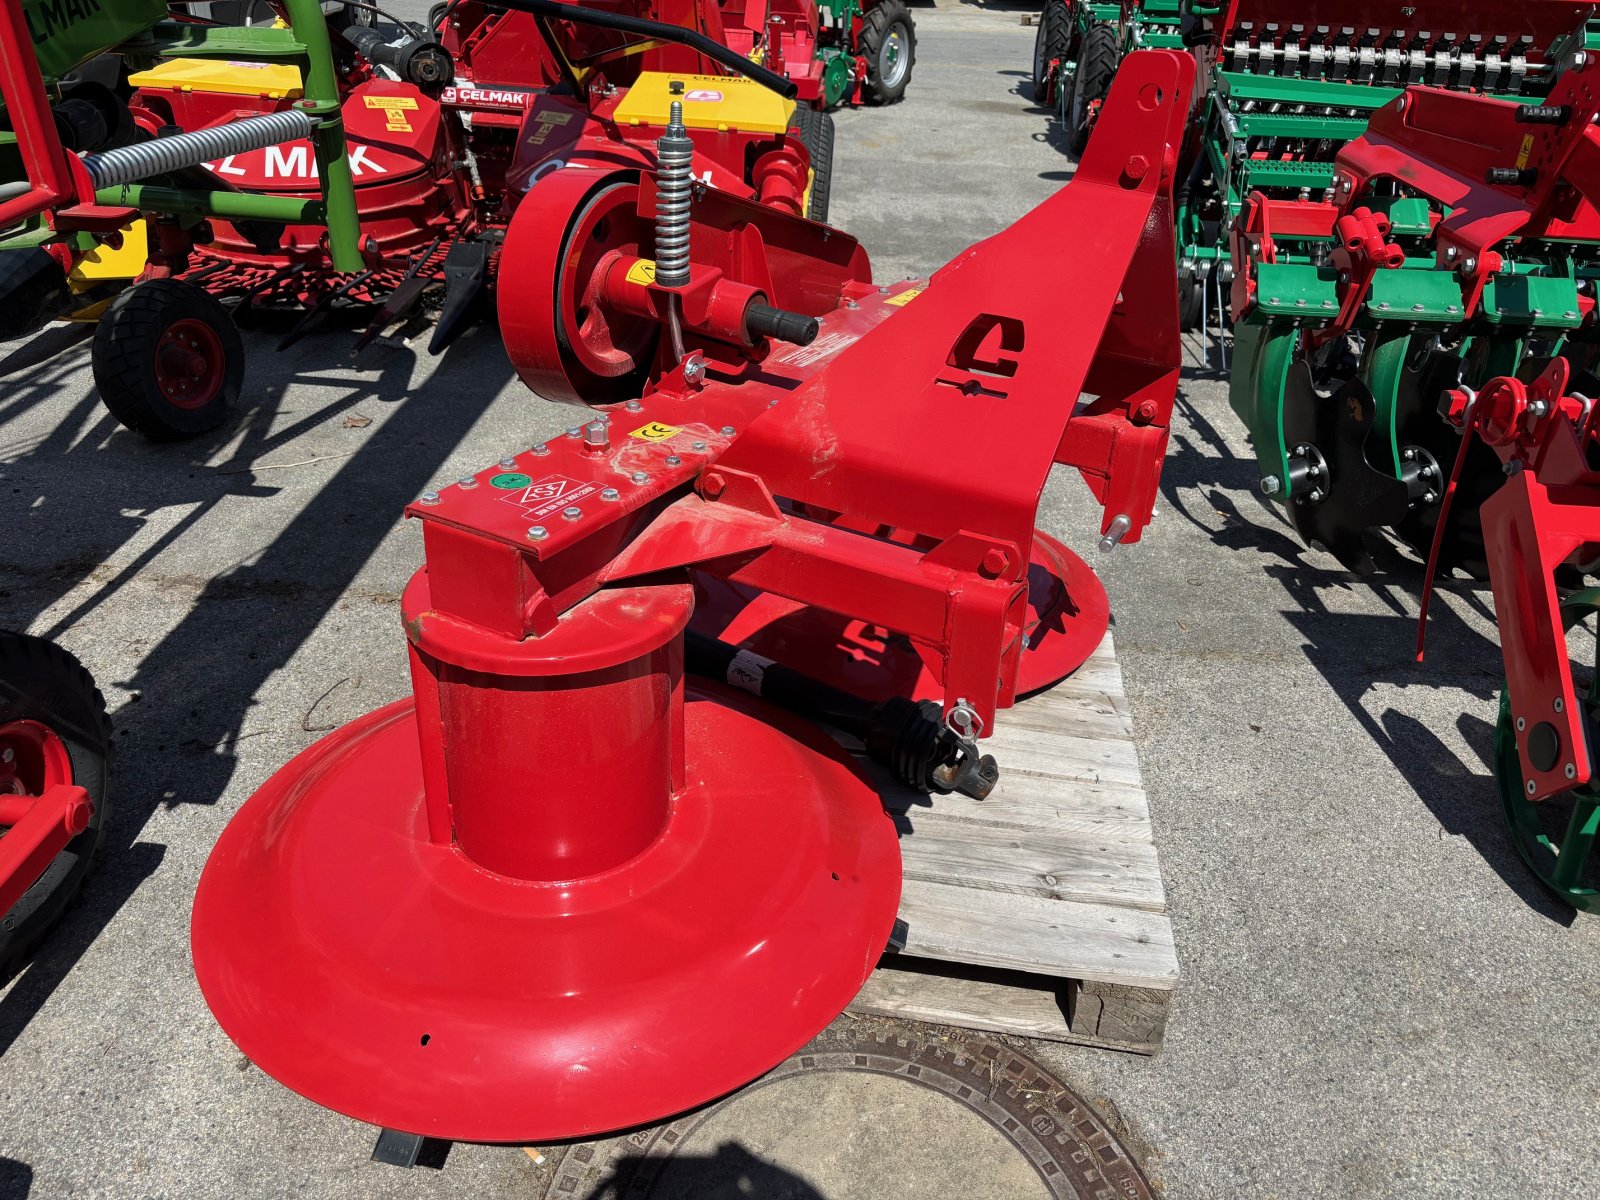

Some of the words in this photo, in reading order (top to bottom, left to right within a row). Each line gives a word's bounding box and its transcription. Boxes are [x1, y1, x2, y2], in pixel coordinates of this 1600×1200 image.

[459, 89, 524, 104] ÇELMAK
[641, 424, 672, 438] CE
[529, 484, 559, 499] TSE
